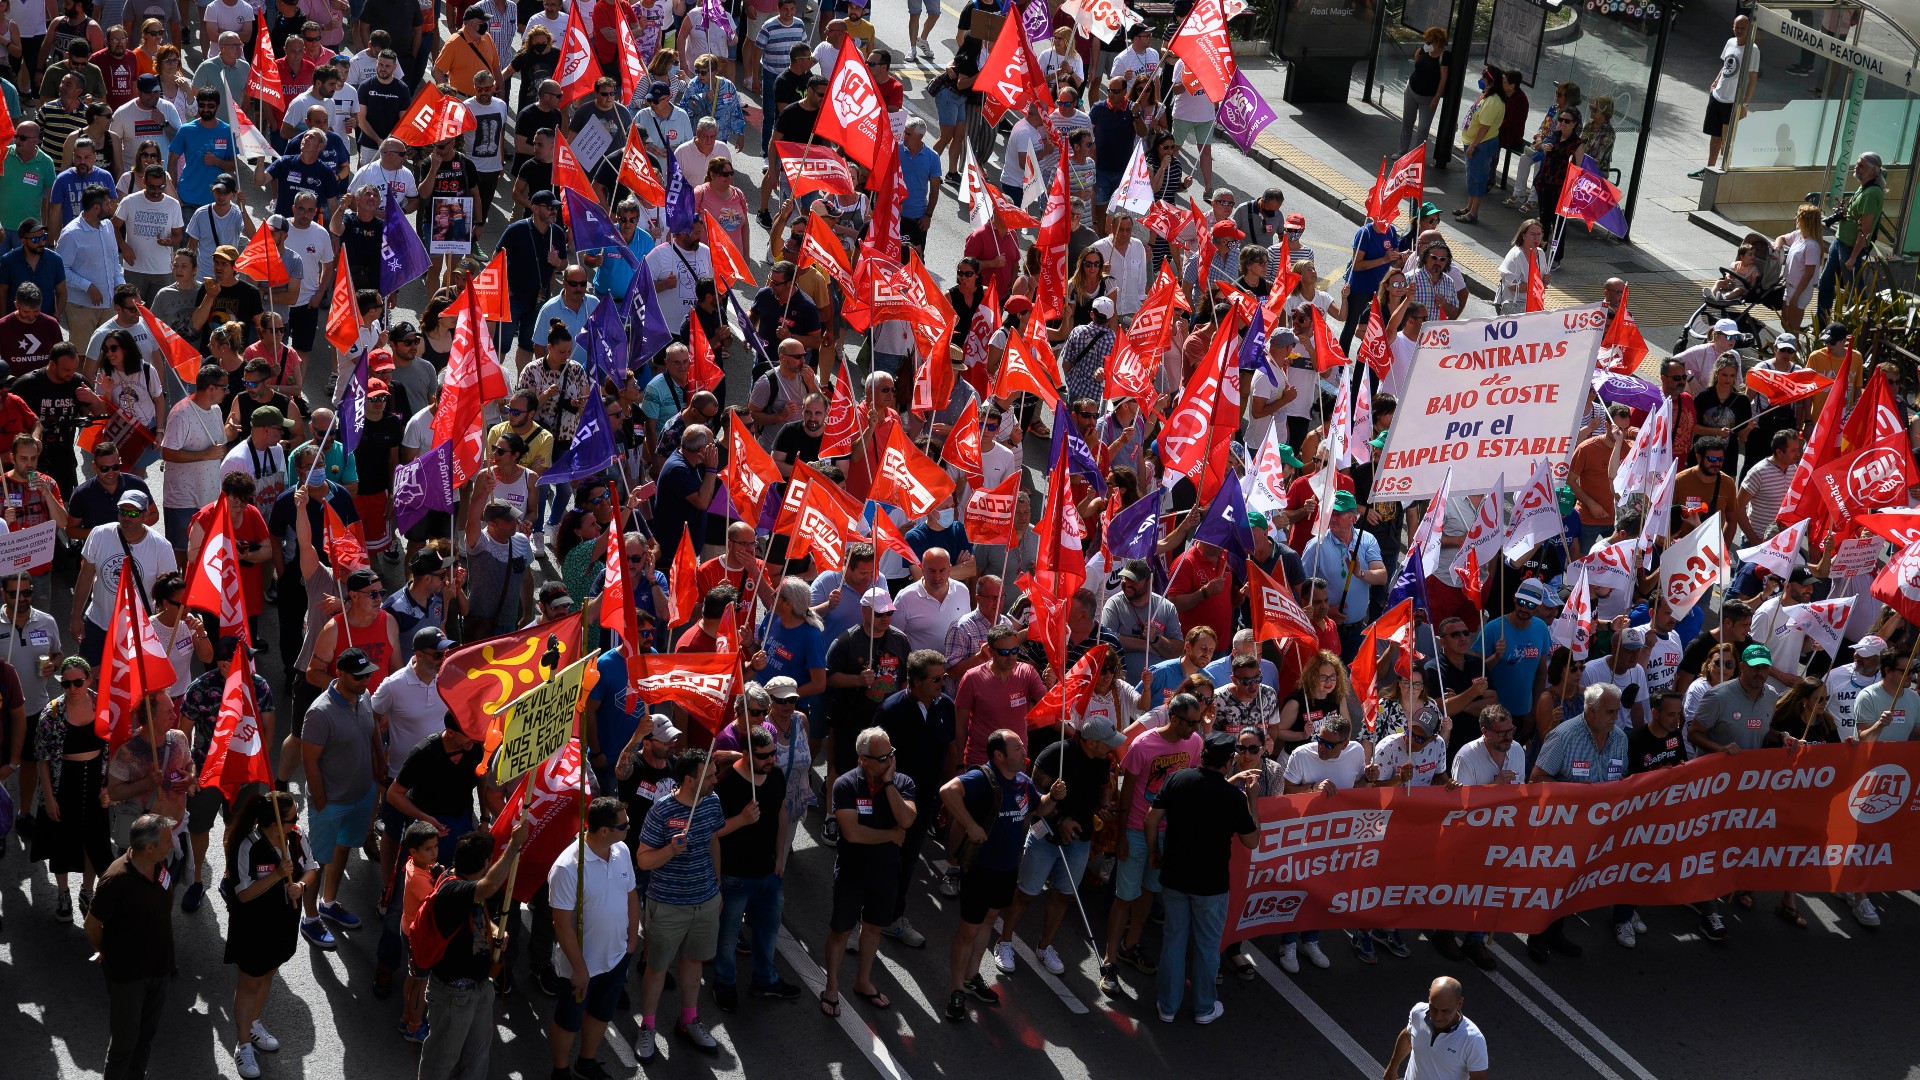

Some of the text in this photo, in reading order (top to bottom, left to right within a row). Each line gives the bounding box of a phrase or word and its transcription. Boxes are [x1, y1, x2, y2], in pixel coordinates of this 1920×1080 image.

[1310, 7, 1354, 17] Real Magic
[1780, 21, 1884, 76] ENTRADA PEATONAL
[368, 90, 399, 99] Champion
[1834, 77, 1866, 192] MONASTERIO
[1484, 320, 1518, 342] NO
[1564, 310, 1606, 330] USO
[1419, 327, 1450, 347] USO
[1438, 340, 1569, 371] CONTRATAS
[1479, 372, 1512, 387] de
[1425, 383, 1560, 416] BAJO COSTE
[1444, 414, 1514, 441] Por el
[1383, 436, 1573, 471] EMPLEO ESTABLE
[437, 448, 453, 506] www.ugt.es
[1373, 475, 1413, 493] USO
[1257, 481, 1276, 503] OBRERA
[16, 531, 46, 544] INDUSTRIA
[1264, 591, 1308, 622] CCOO
[1646, 656, 1663, 669] HAZ
[1647, 667, 1675, 682] DE TUS
[513, 676, 564, 720] REVILLA
[522, 684, 579, 733] MARCANO
[1837, 691, 1857, 700] HAZ
[1839, 705, 1851, 714] DE
[504, 703, 575, 761] NOS ESTAIS
[510, 727, 565, 778] PELANDO
[640, 780, 652, 790] UGT
[1441, 765, 1836, 828] POR UN CONVENIO DIGNO
[1858, 773, 1907, 795] UGT
[1258, 815, 1354, 854] CCOO
[1484, 808, 1777, 868] PARA LA INDUSTRIA
[1246, 844, 1380, 889] industria
[1679, 850, 1717, 880] DE
[1722, 842, 1894, 869] CANTABRIA
[1241, 895, 1302, 920] USO
